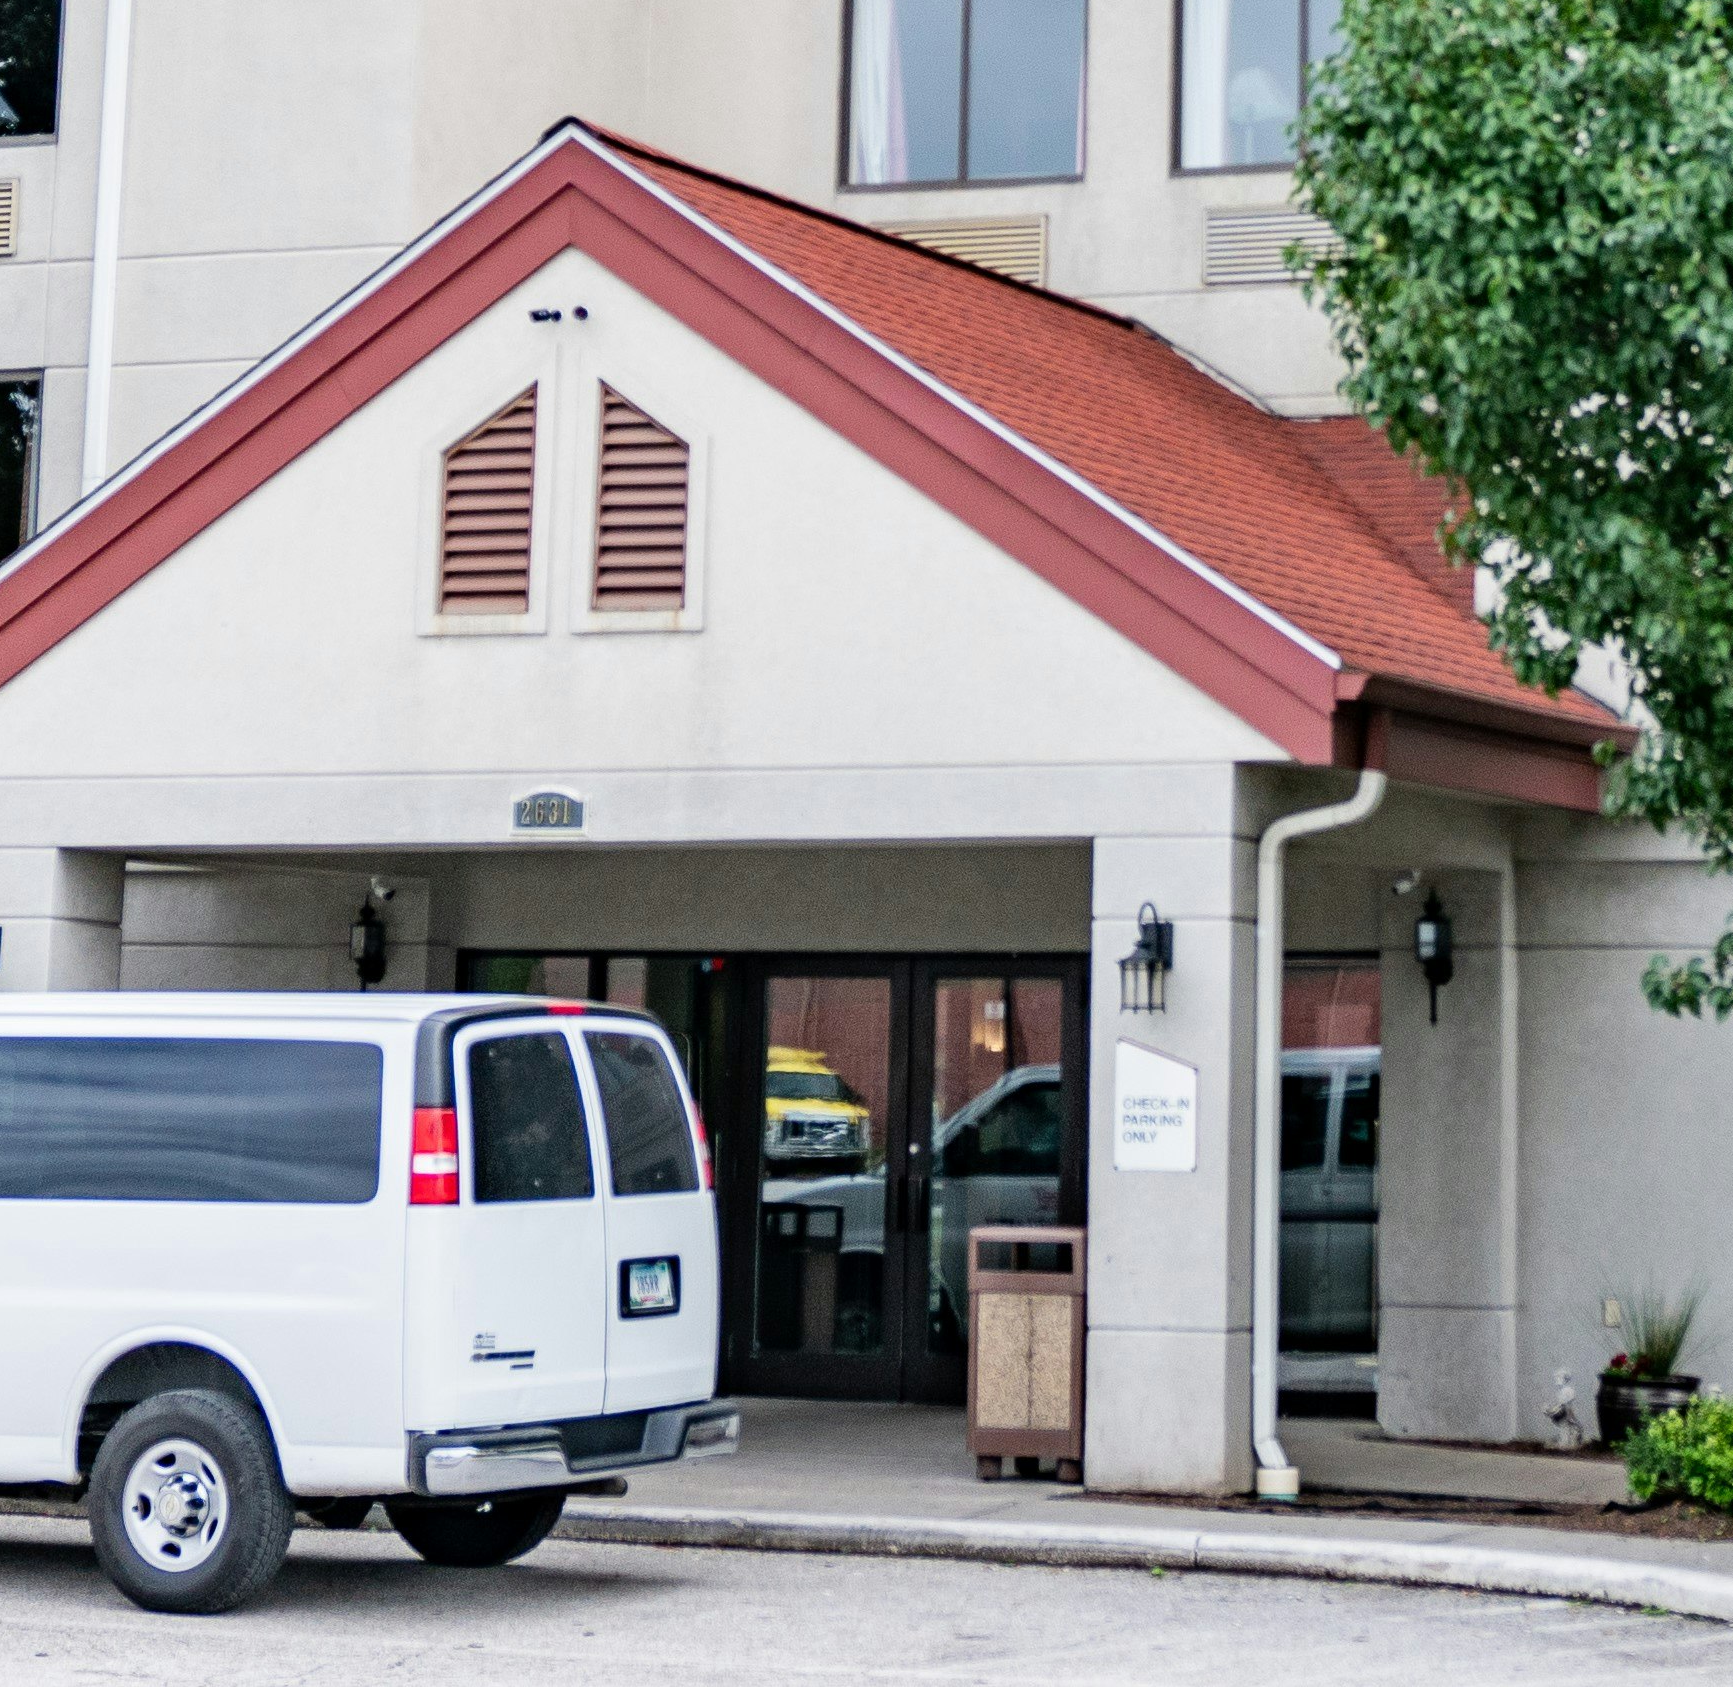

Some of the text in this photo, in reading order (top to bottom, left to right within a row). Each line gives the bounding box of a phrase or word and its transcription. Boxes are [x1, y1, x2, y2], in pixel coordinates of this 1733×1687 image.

[520, 799, 570, 825] 2631
[1123, 1097, 1190, 1110] CHECK-IN
[1123, 1114, 1182, 1127] PARKING
[1122, 1131, 1157, 1144] ONLY
